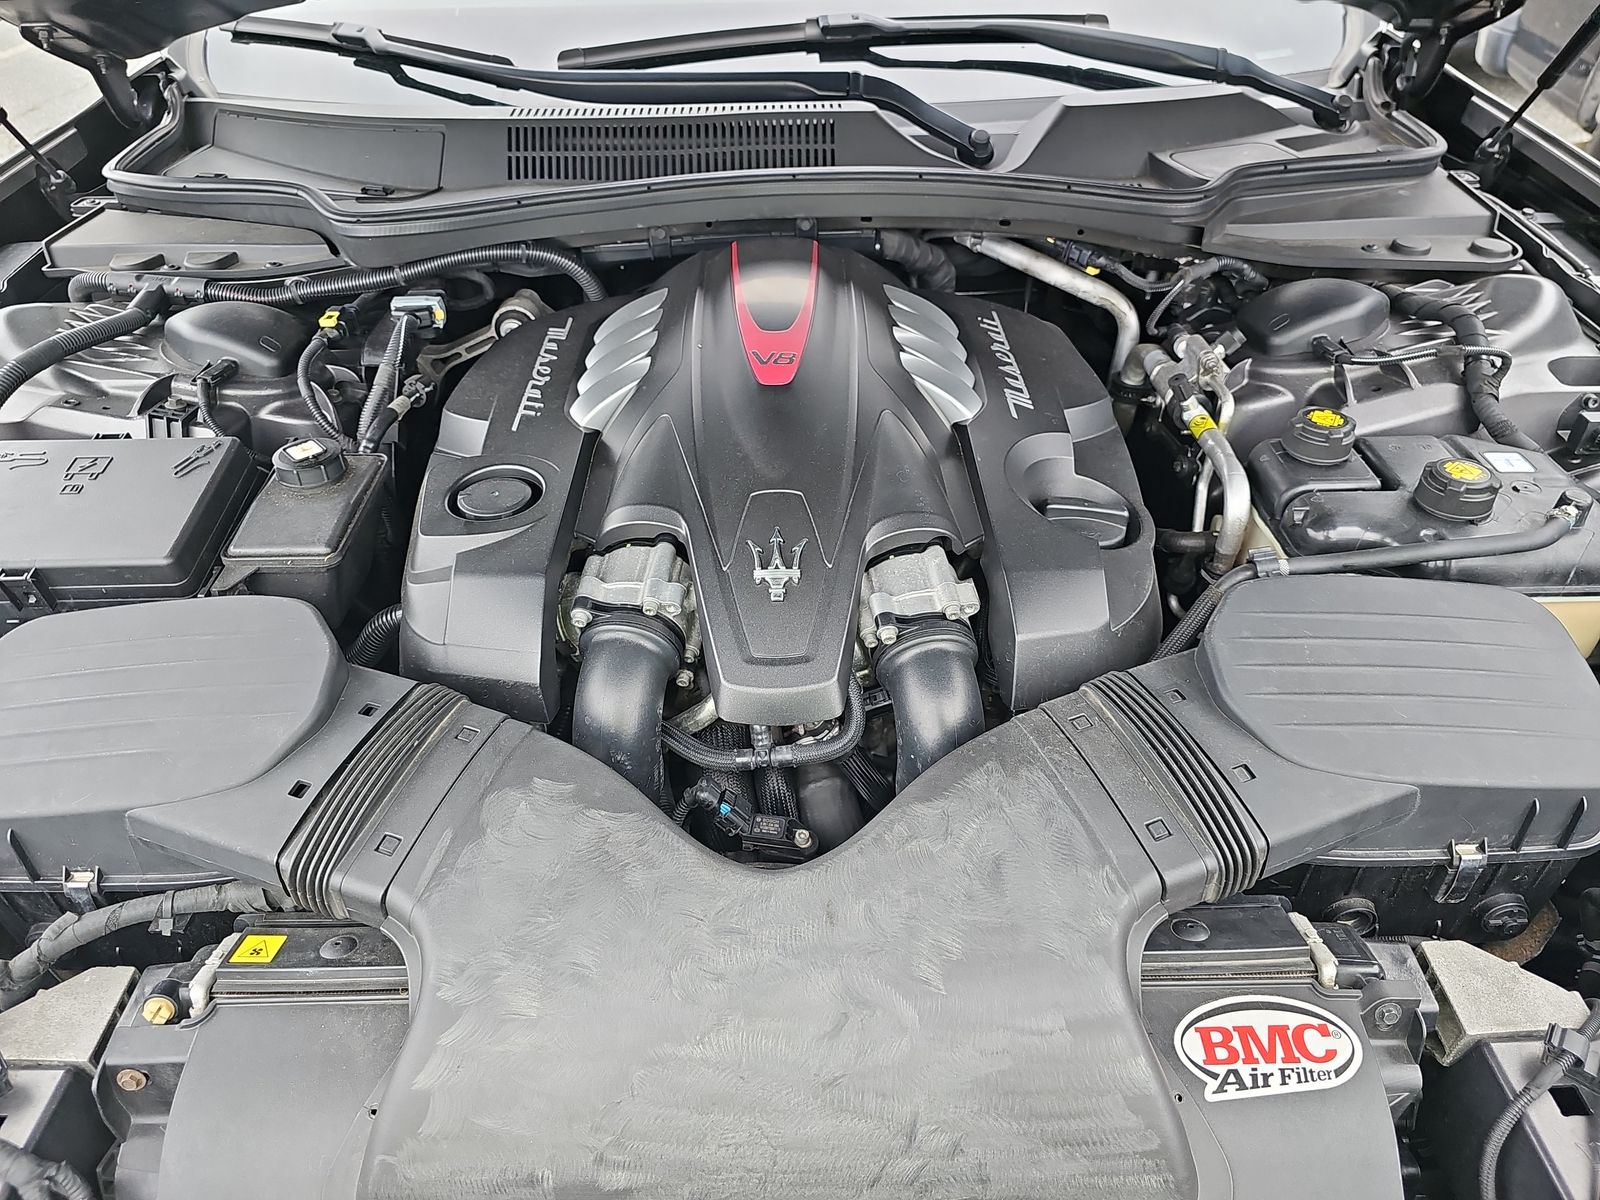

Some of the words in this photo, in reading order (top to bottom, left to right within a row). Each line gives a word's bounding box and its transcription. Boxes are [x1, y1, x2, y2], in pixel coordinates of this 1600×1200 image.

[511, 317, 573, 432] Maserati
[751, 350, 797, 366] V8
[977, 310, 1034, 420] Maserati
[1194, 1023, 1338, 1066] BMC
[1211, 1067, 1275, 1095] Air
[1278, 1066, 1333, 1087] Filter
